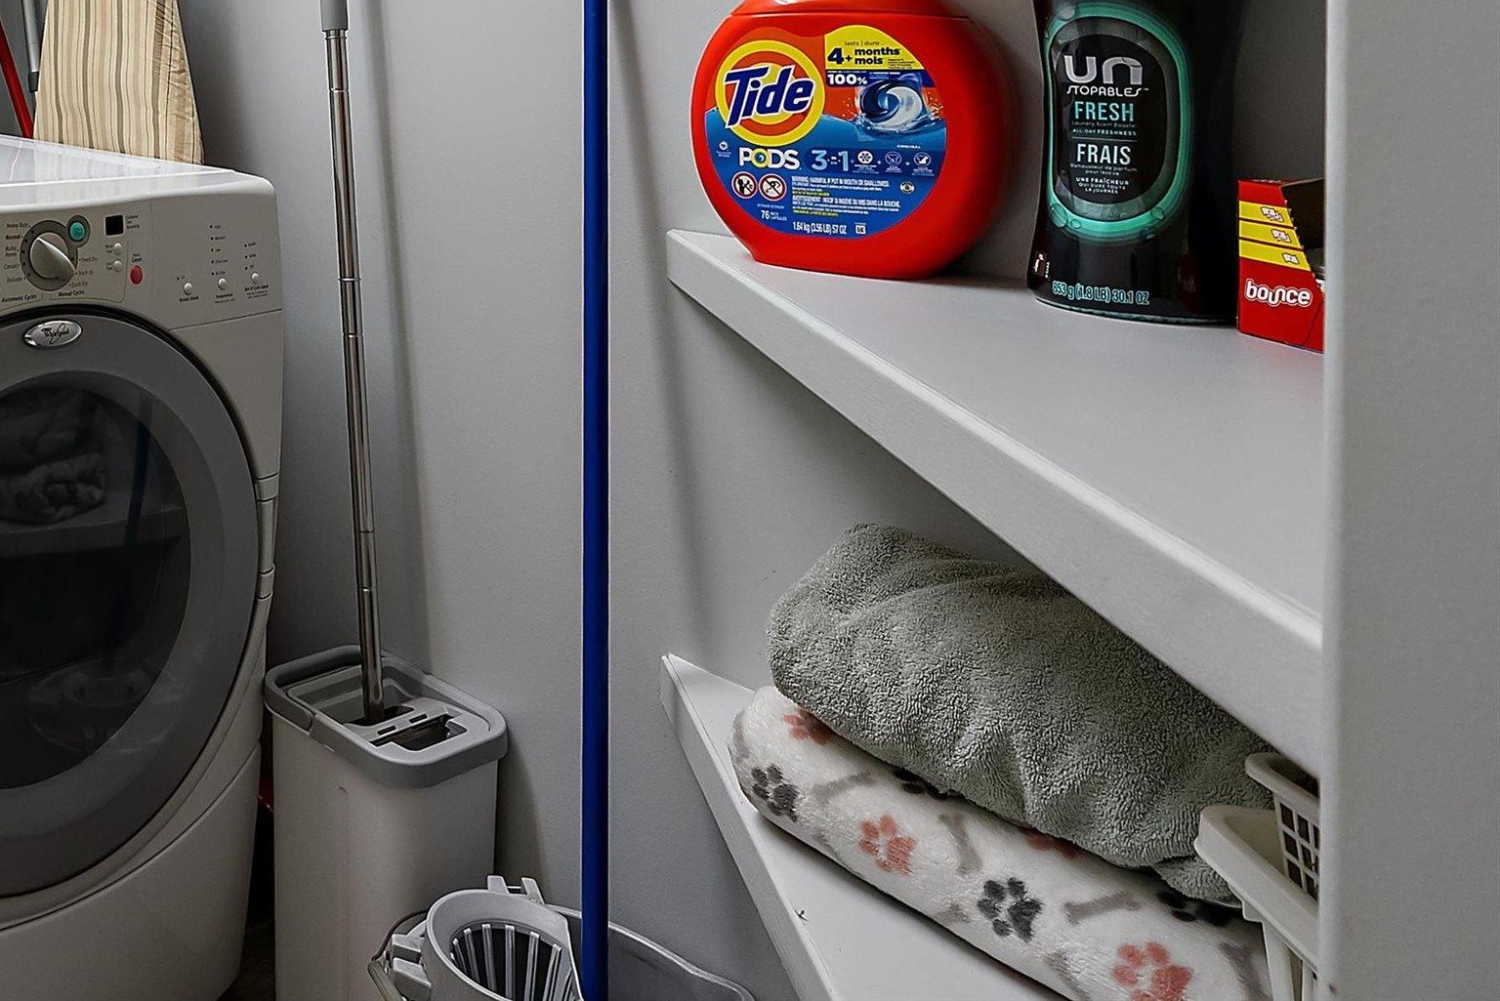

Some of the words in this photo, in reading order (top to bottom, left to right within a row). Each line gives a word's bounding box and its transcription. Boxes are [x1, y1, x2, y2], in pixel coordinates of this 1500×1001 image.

[854, 47, 900, 56] months
[827, 74, 867, 85] 100%
[725, 65, 815, 128] Tide
[1074, 101, 1134, 122] FRESH
[738, 147, 800, 170] PODS
[1077, 143, 1131, 166] FRAIS
[1245, 279, 1312, 307] bounce
